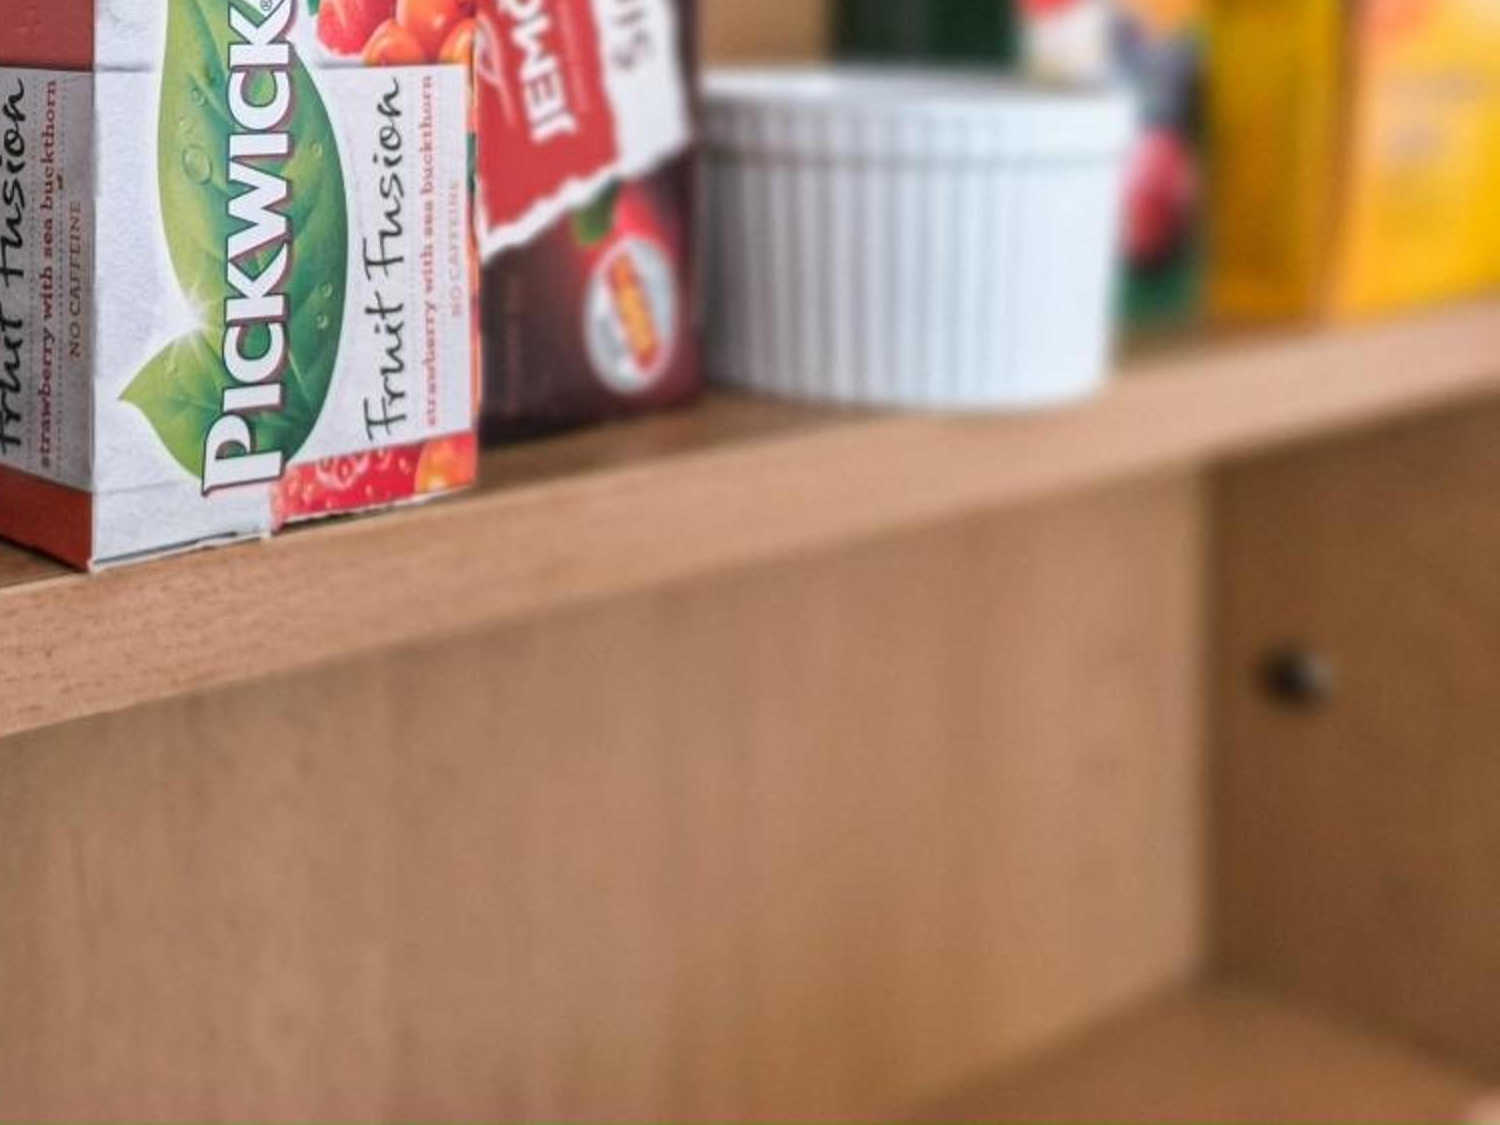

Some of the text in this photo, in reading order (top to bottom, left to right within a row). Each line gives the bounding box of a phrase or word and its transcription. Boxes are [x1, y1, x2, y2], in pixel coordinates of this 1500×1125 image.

[419, 74, 436, 194] buckthorn
[37, 79, 57, 470] strawberry with sea buckthorn
[68, 200, 82, 359] NO CAFFEINE
[362, 76, 407, 441] Fruit Fusion
[420, 243, 436, 295] with
[421, 300, 439, 427] strawberry
